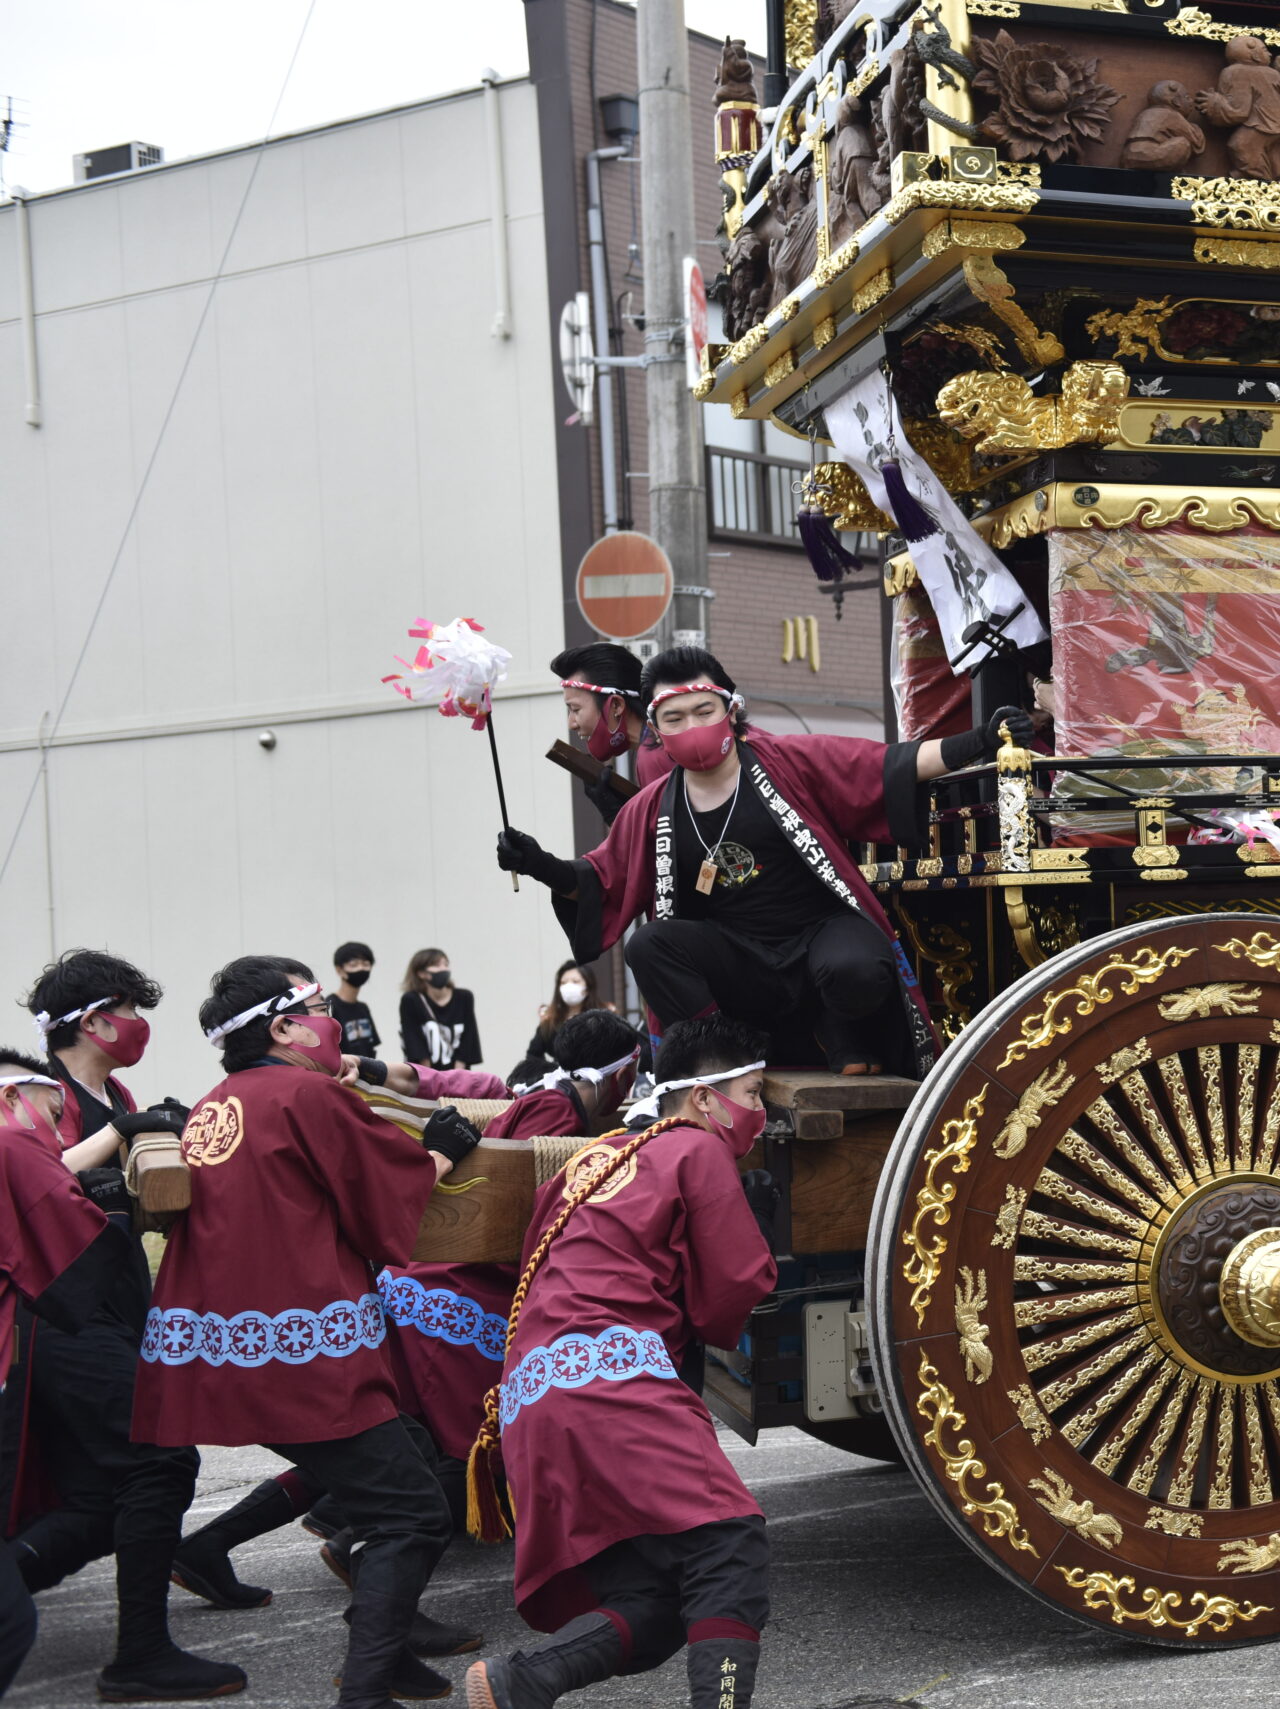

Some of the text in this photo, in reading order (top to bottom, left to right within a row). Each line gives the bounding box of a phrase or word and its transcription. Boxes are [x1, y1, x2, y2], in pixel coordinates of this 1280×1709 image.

[655, 816, 675, 921] 三日曽根曳
